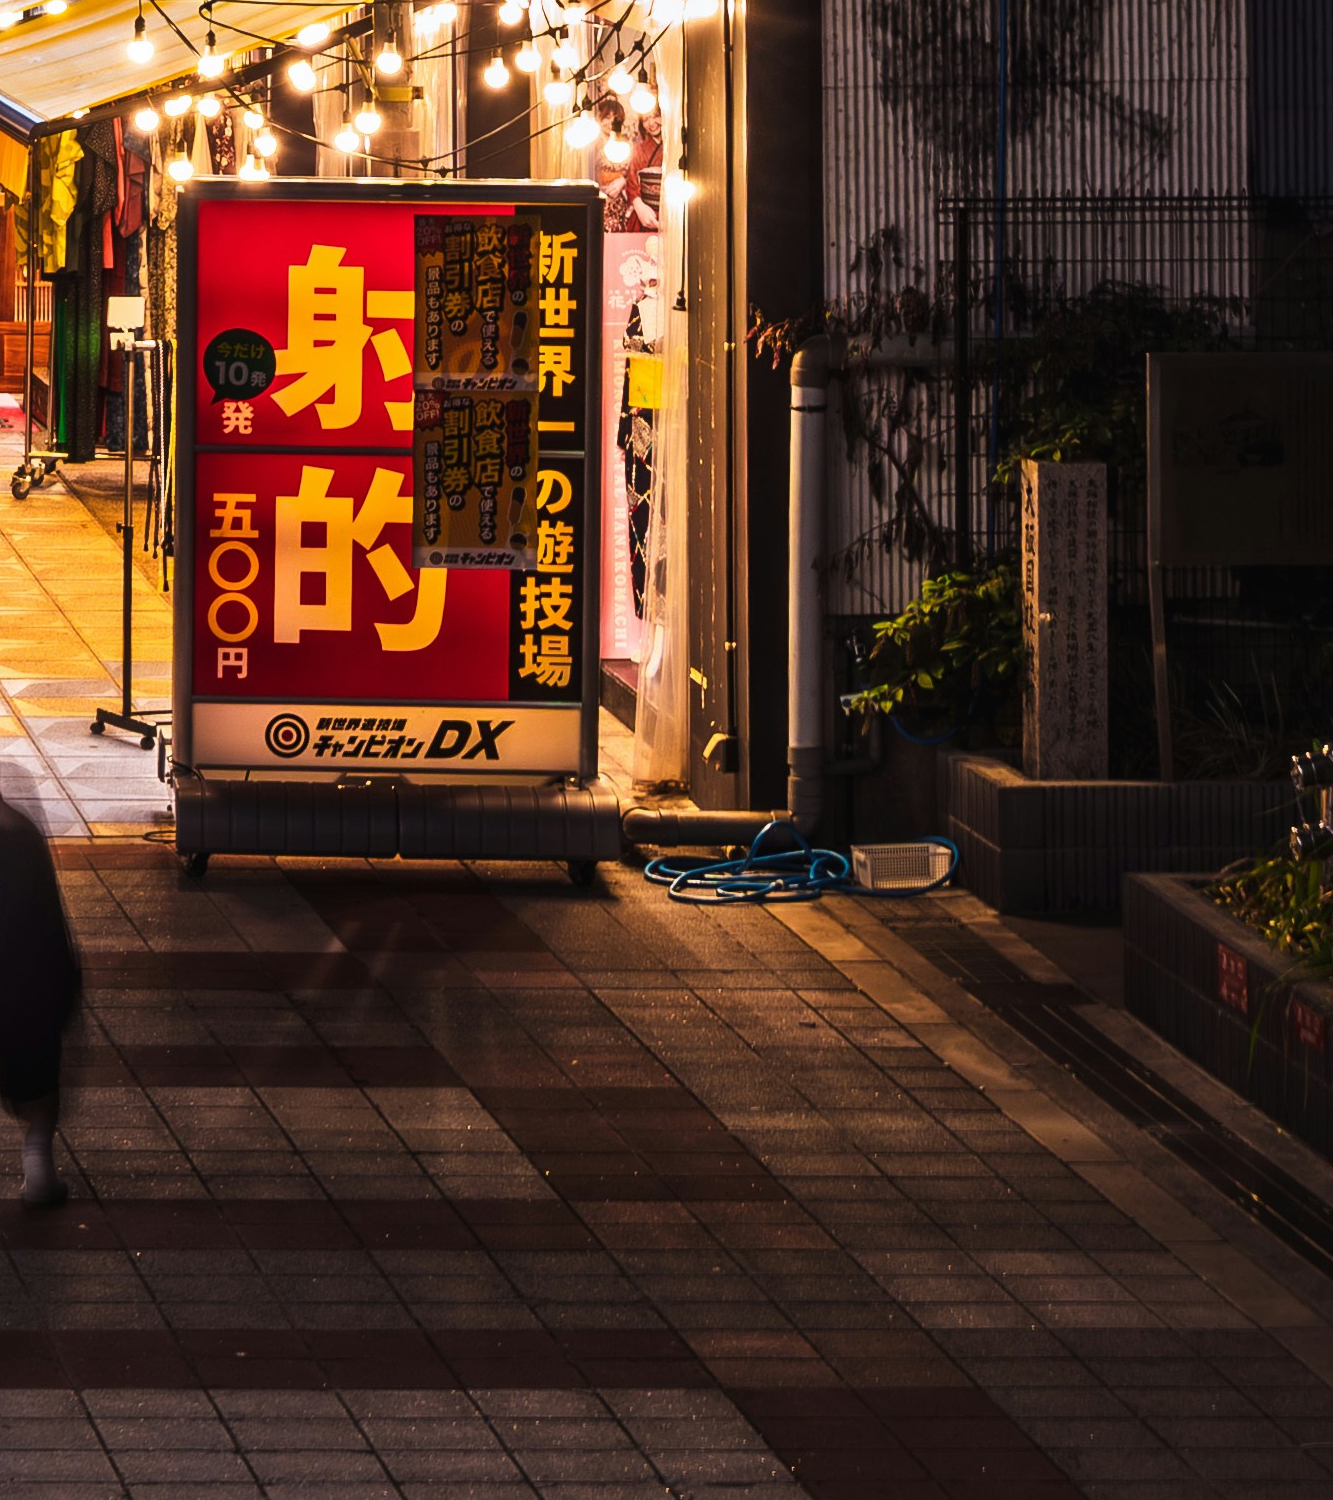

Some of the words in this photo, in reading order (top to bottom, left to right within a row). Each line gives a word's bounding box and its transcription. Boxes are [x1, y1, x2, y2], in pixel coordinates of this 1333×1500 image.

[444, 236, 472, 334] 割引券の
[475, 226, 505, 367] 飲食店で使える
[214, 361, 267, 387] 10発
[216, 341, 266, 362] 今だけ
[222, 401, 253, 436] 発
[271, 243, 449, 652] 射的
[444, 408, 471, 508] 割引券の
[474, 401, 502, 541] 飲食店で使える
[312, 734, 425, 759] チャンピオン
[424, 719, 516, 761] DX
[316, 717, 408, 732] 新世界遊技場
